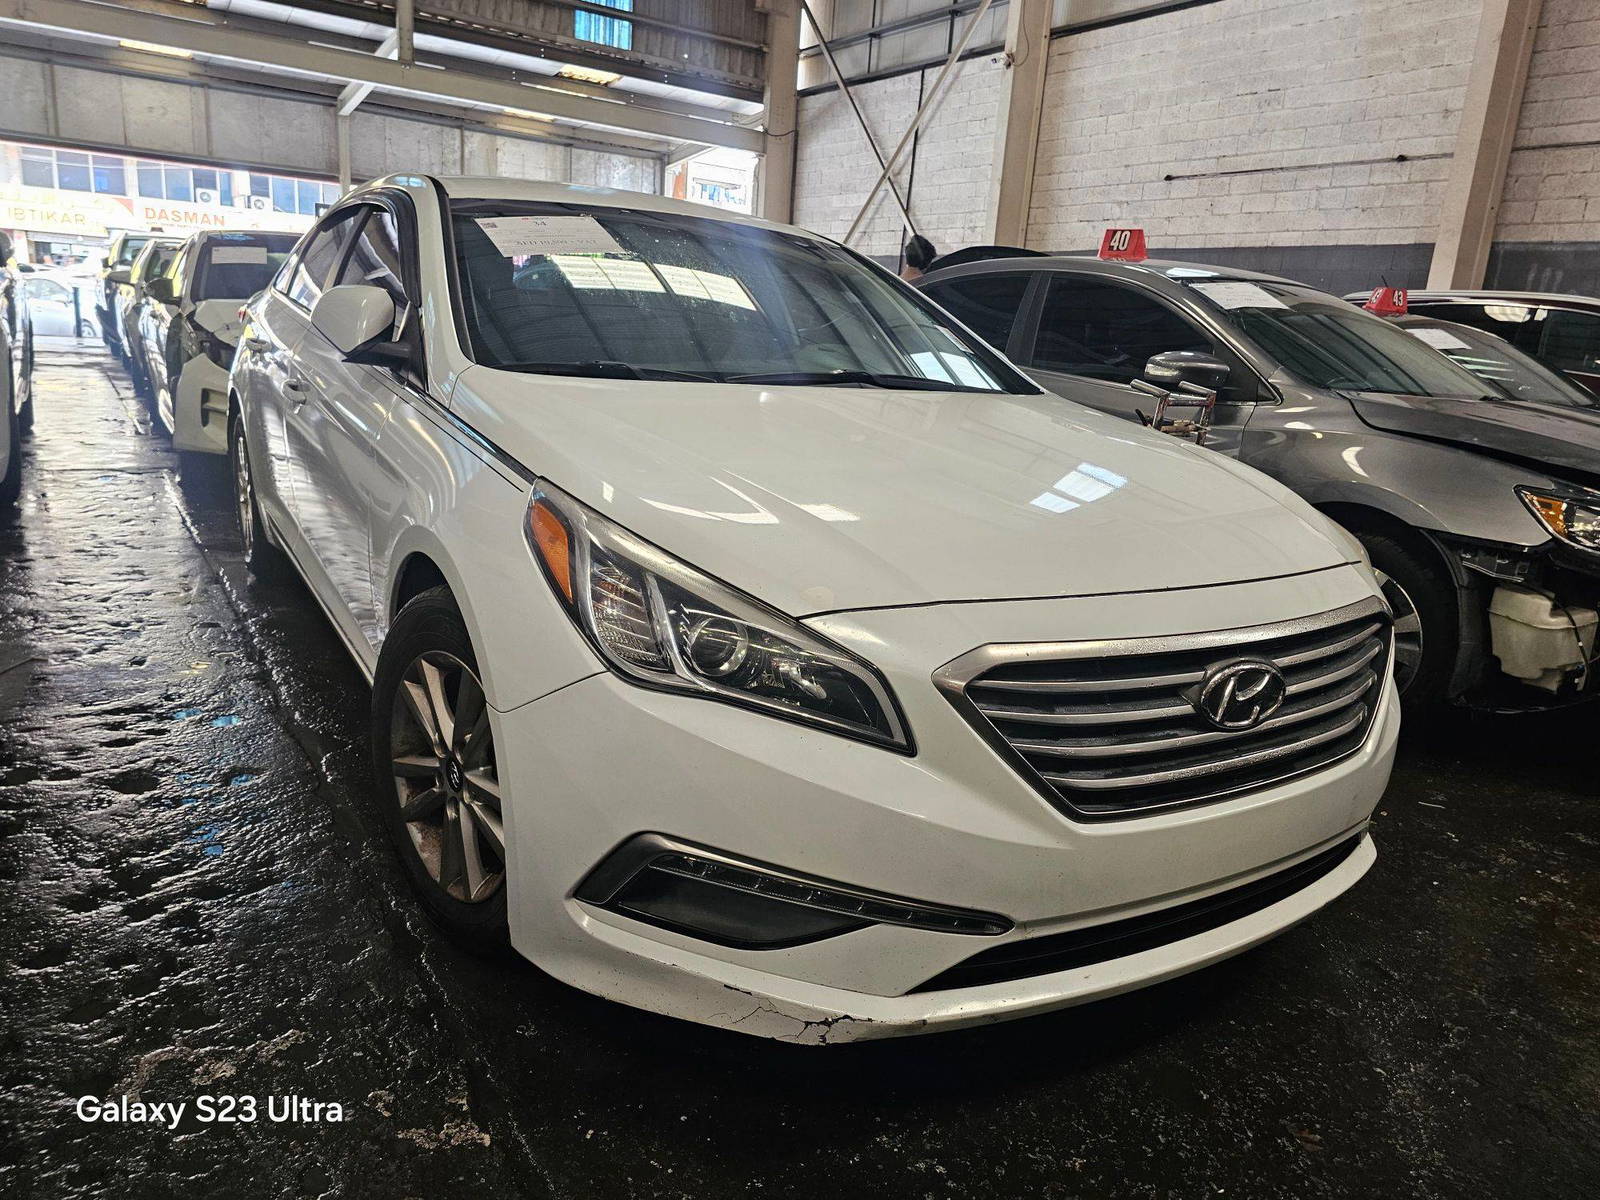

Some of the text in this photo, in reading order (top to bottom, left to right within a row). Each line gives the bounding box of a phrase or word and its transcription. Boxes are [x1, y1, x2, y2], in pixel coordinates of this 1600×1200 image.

[7, 207, 86, 225] IBTIKAR
[143, 207, 225, 227] DASMAN
[1109, 230, 1131, 251] 40
[1392, 289, 1404, 307] 43
